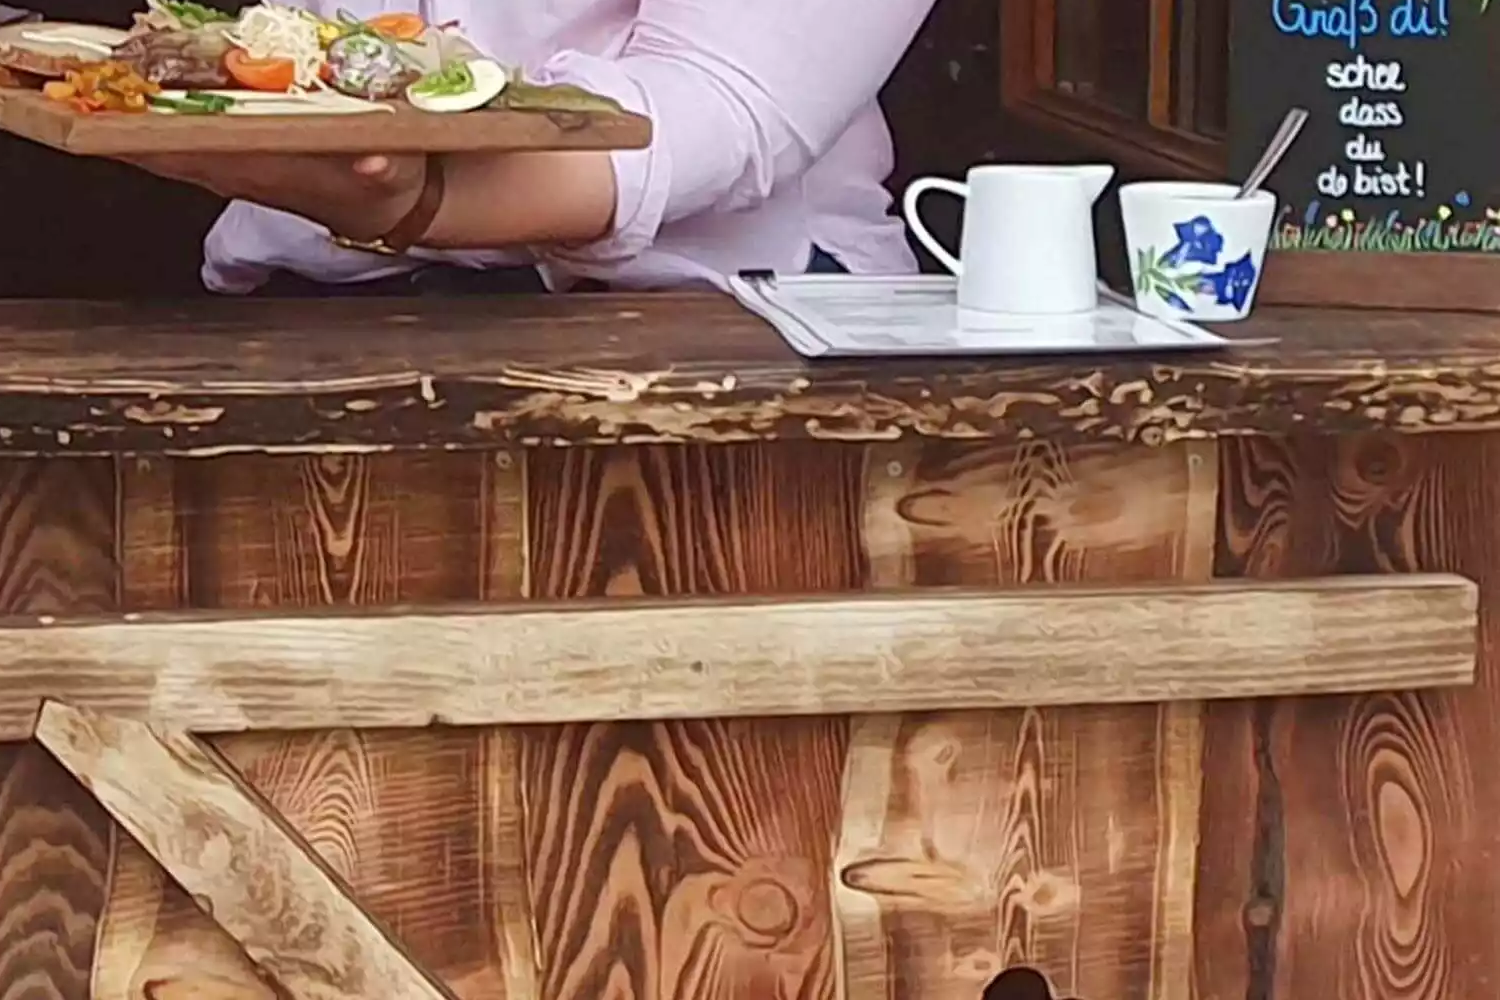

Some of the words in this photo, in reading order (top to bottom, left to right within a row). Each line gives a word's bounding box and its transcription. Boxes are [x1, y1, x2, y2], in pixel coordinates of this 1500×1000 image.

[1338, 95, 1403, 126] dass
[1345, 132, 1387, 161] du
[1317, 163, 1349, 198] do
[1353, 160, 1425, 198] bist!
